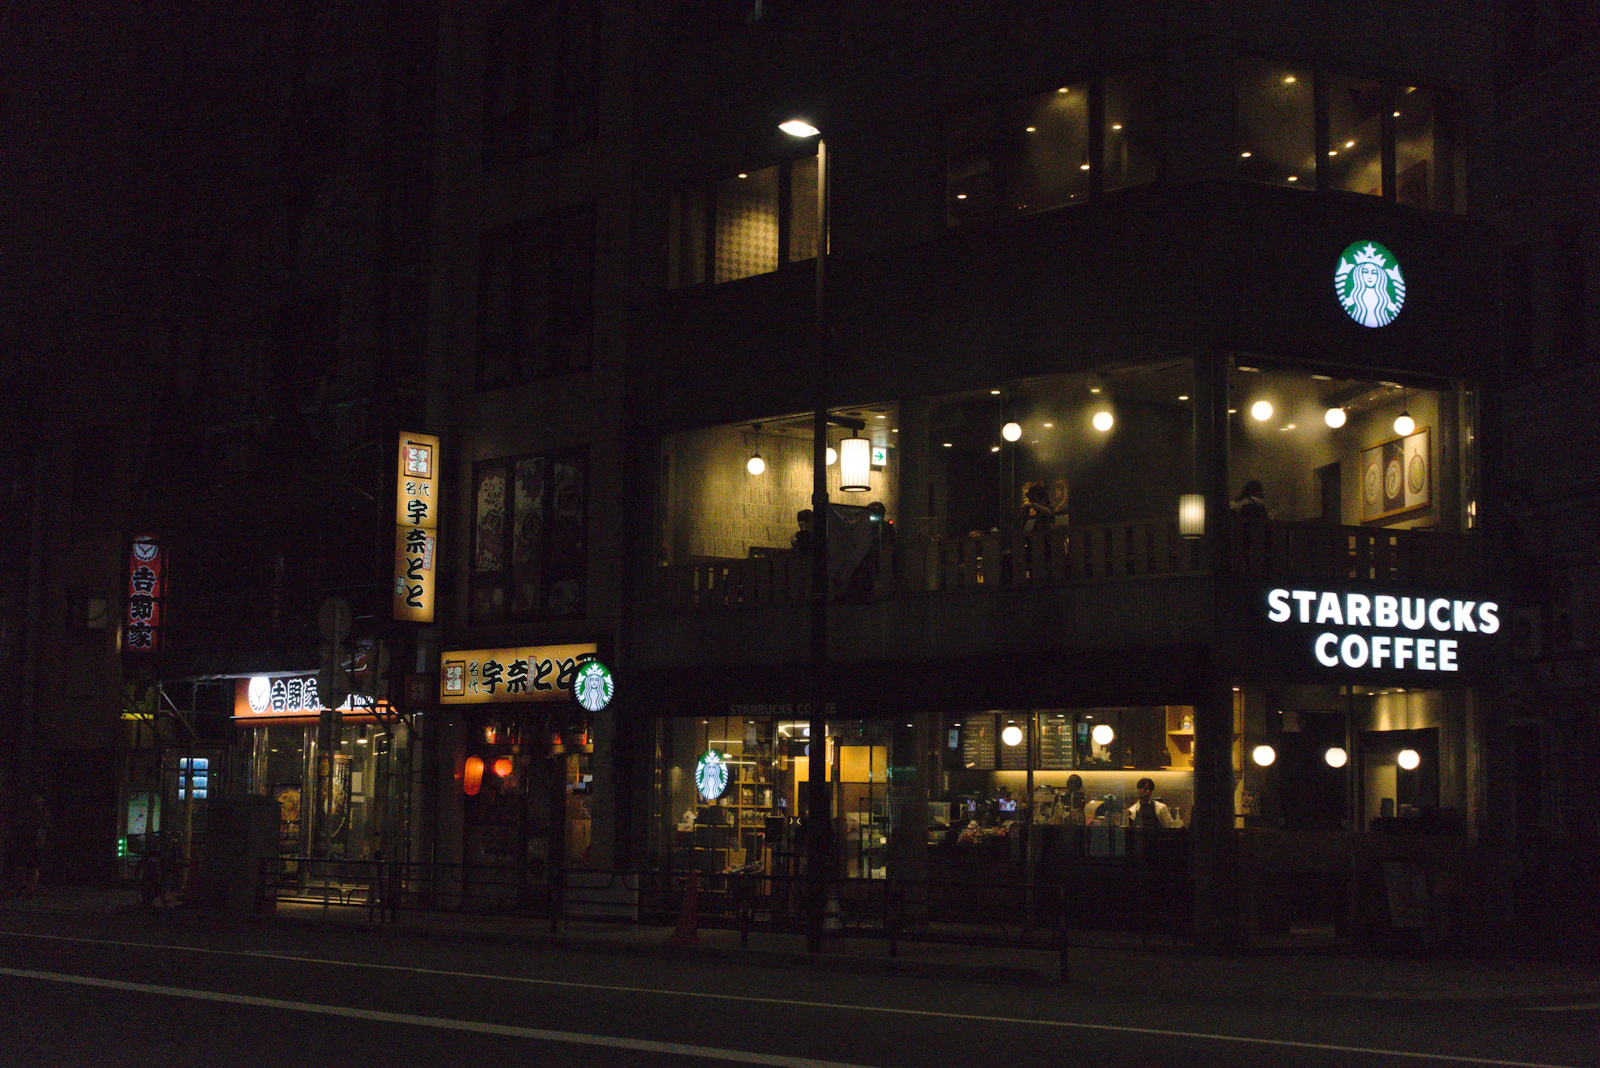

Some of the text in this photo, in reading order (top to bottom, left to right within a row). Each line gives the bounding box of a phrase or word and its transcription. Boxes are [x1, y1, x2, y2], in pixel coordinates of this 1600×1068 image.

[405, 482, 430, 497] 名代
[405, 499, 428, 608] 宇奈とと
[1267, 588, 1500, 634] STARBUCKS
[1314, 632, 1459, 672] COFFEE
[468, 659, 479, 695] 名代
[729, 702, 837, 715] STARBUCKS COEE
